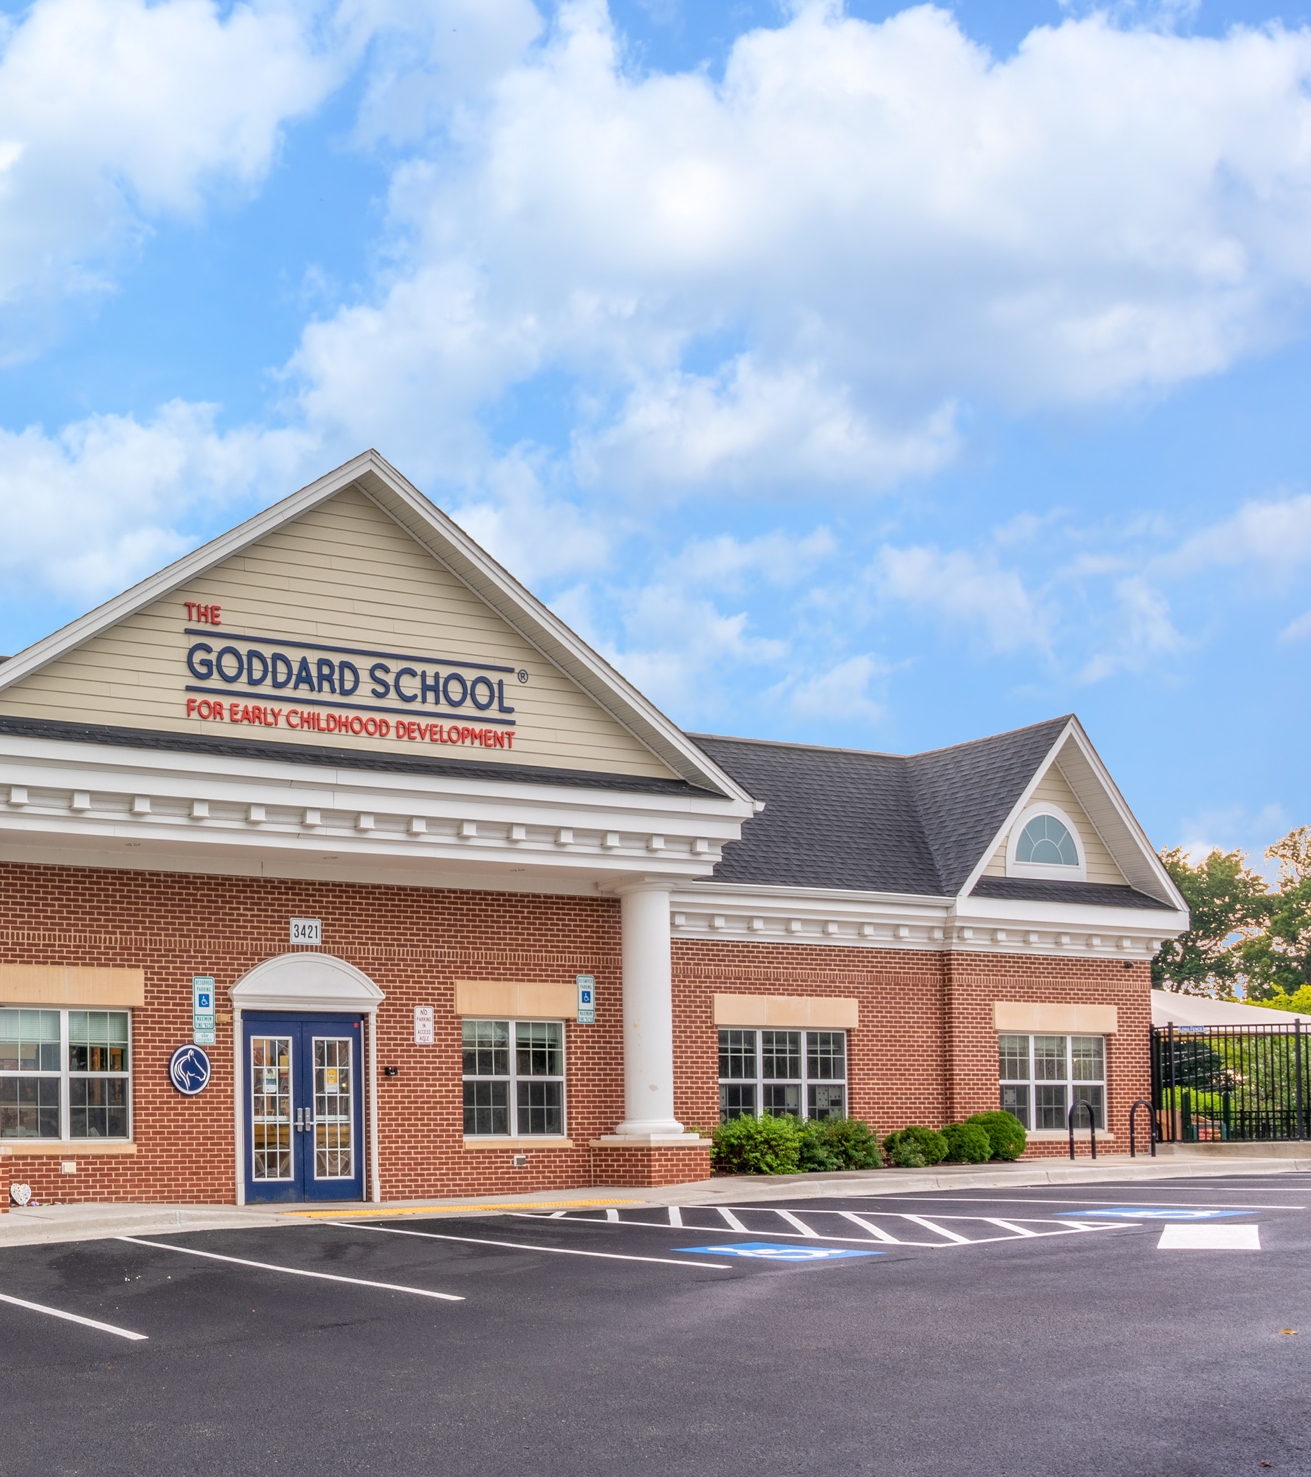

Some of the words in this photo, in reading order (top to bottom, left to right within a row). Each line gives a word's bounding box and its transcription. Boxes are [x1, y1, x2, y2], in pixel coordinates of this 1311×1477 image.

[184, 602, 221, 625] THE
[187, 642, 360, 696] GODDARD
[370, 662, 515, 713] SCHOOL
[187, 698, 224, 721] FOR
[230, 703, 282, 727] EARLY
[286, 709, 391, 737] CHILDHOOD
[396, 720, 516, 749] DEVELOPMENT
[293, 923, 318, 939] 3421
